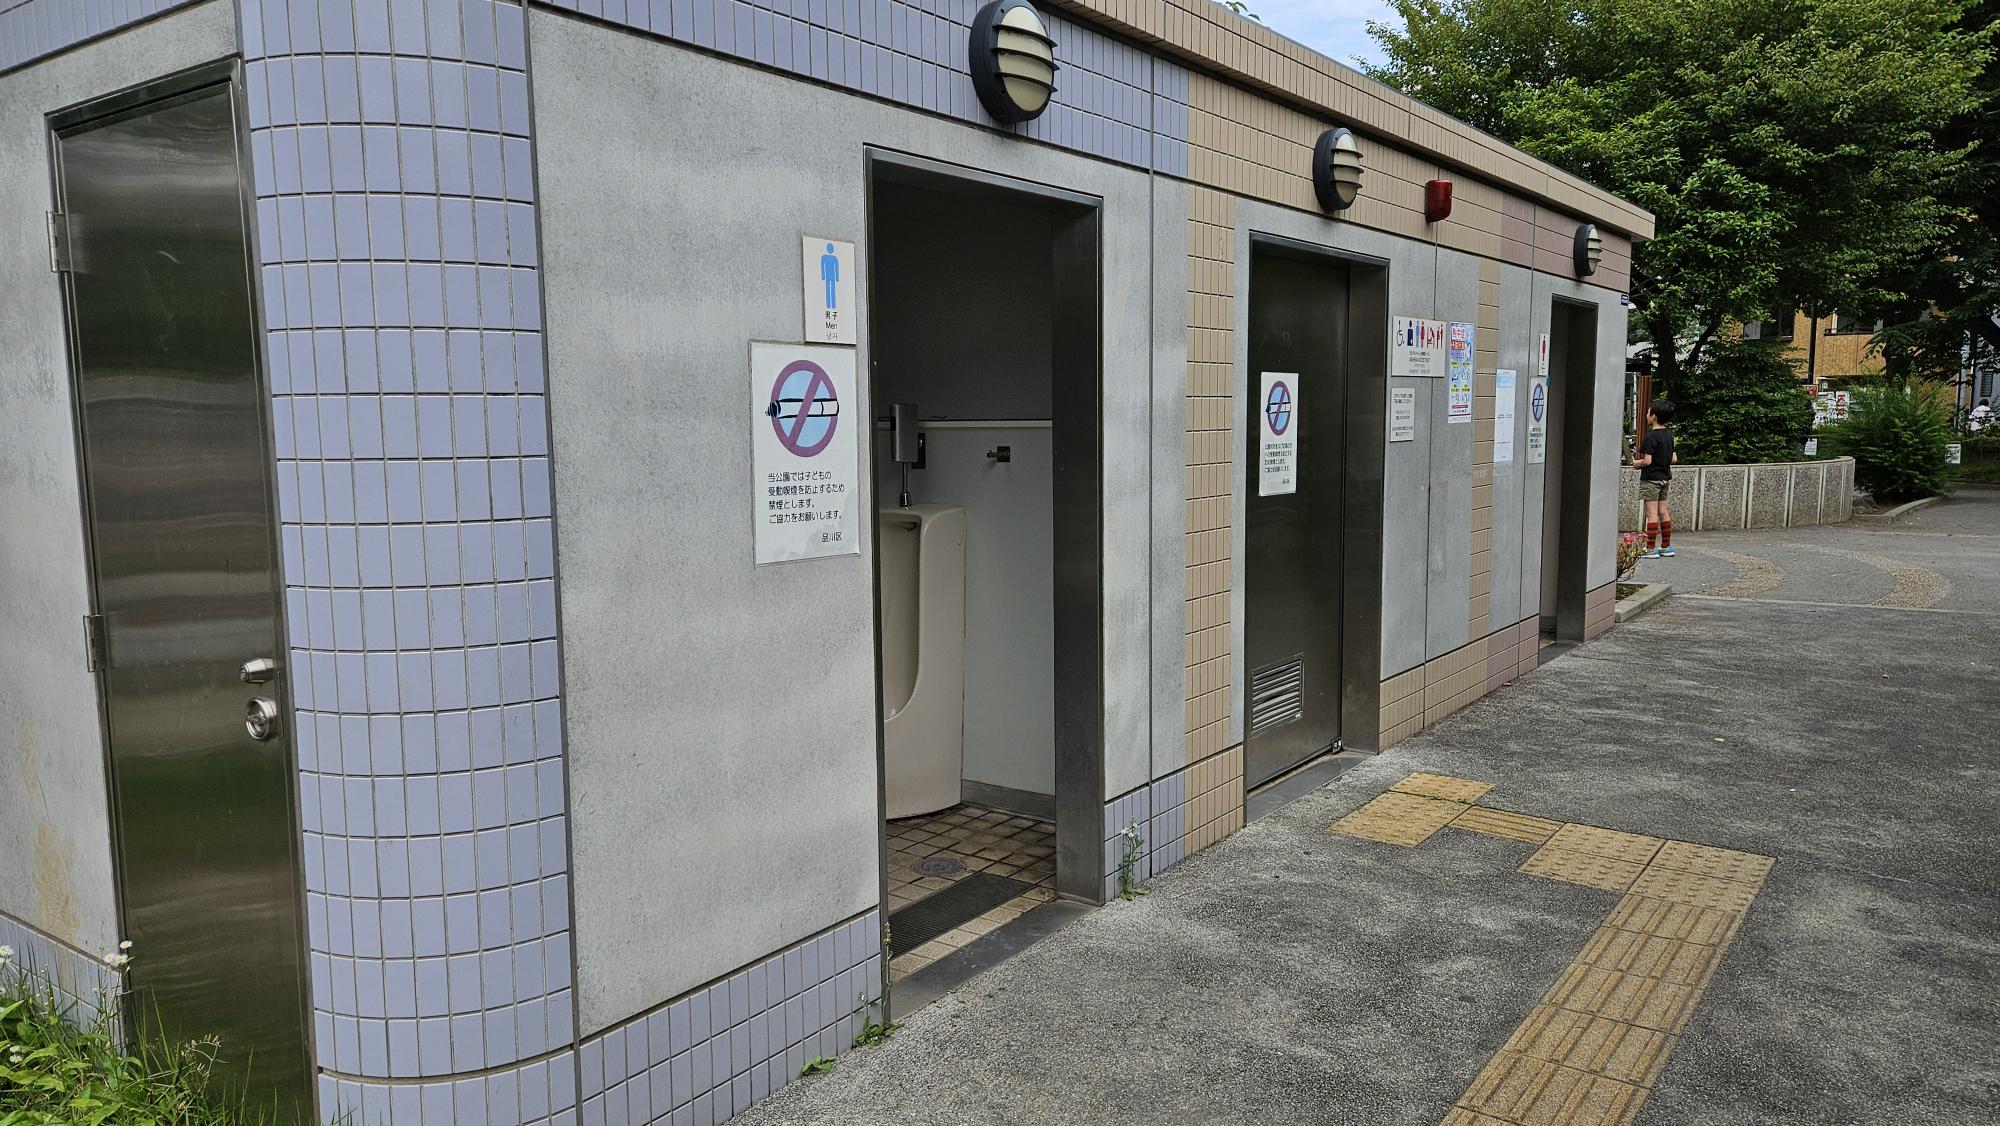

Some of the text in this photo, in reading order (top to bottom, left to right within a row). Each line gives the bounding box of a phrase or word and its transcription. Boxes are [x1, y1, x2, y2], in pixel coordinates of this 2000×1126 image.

[825, 321, 838, 330] Men
[767, 471, 832, 483] 当公園では子どもの
[767, 483, 845, 497] 受動喫煙を防止するため
[768, 498, 815, 510] 禁煙とします。
[769, 510, 842, 524] ご協力をお願いします。
[821, 531, 842, 543] 品川区
